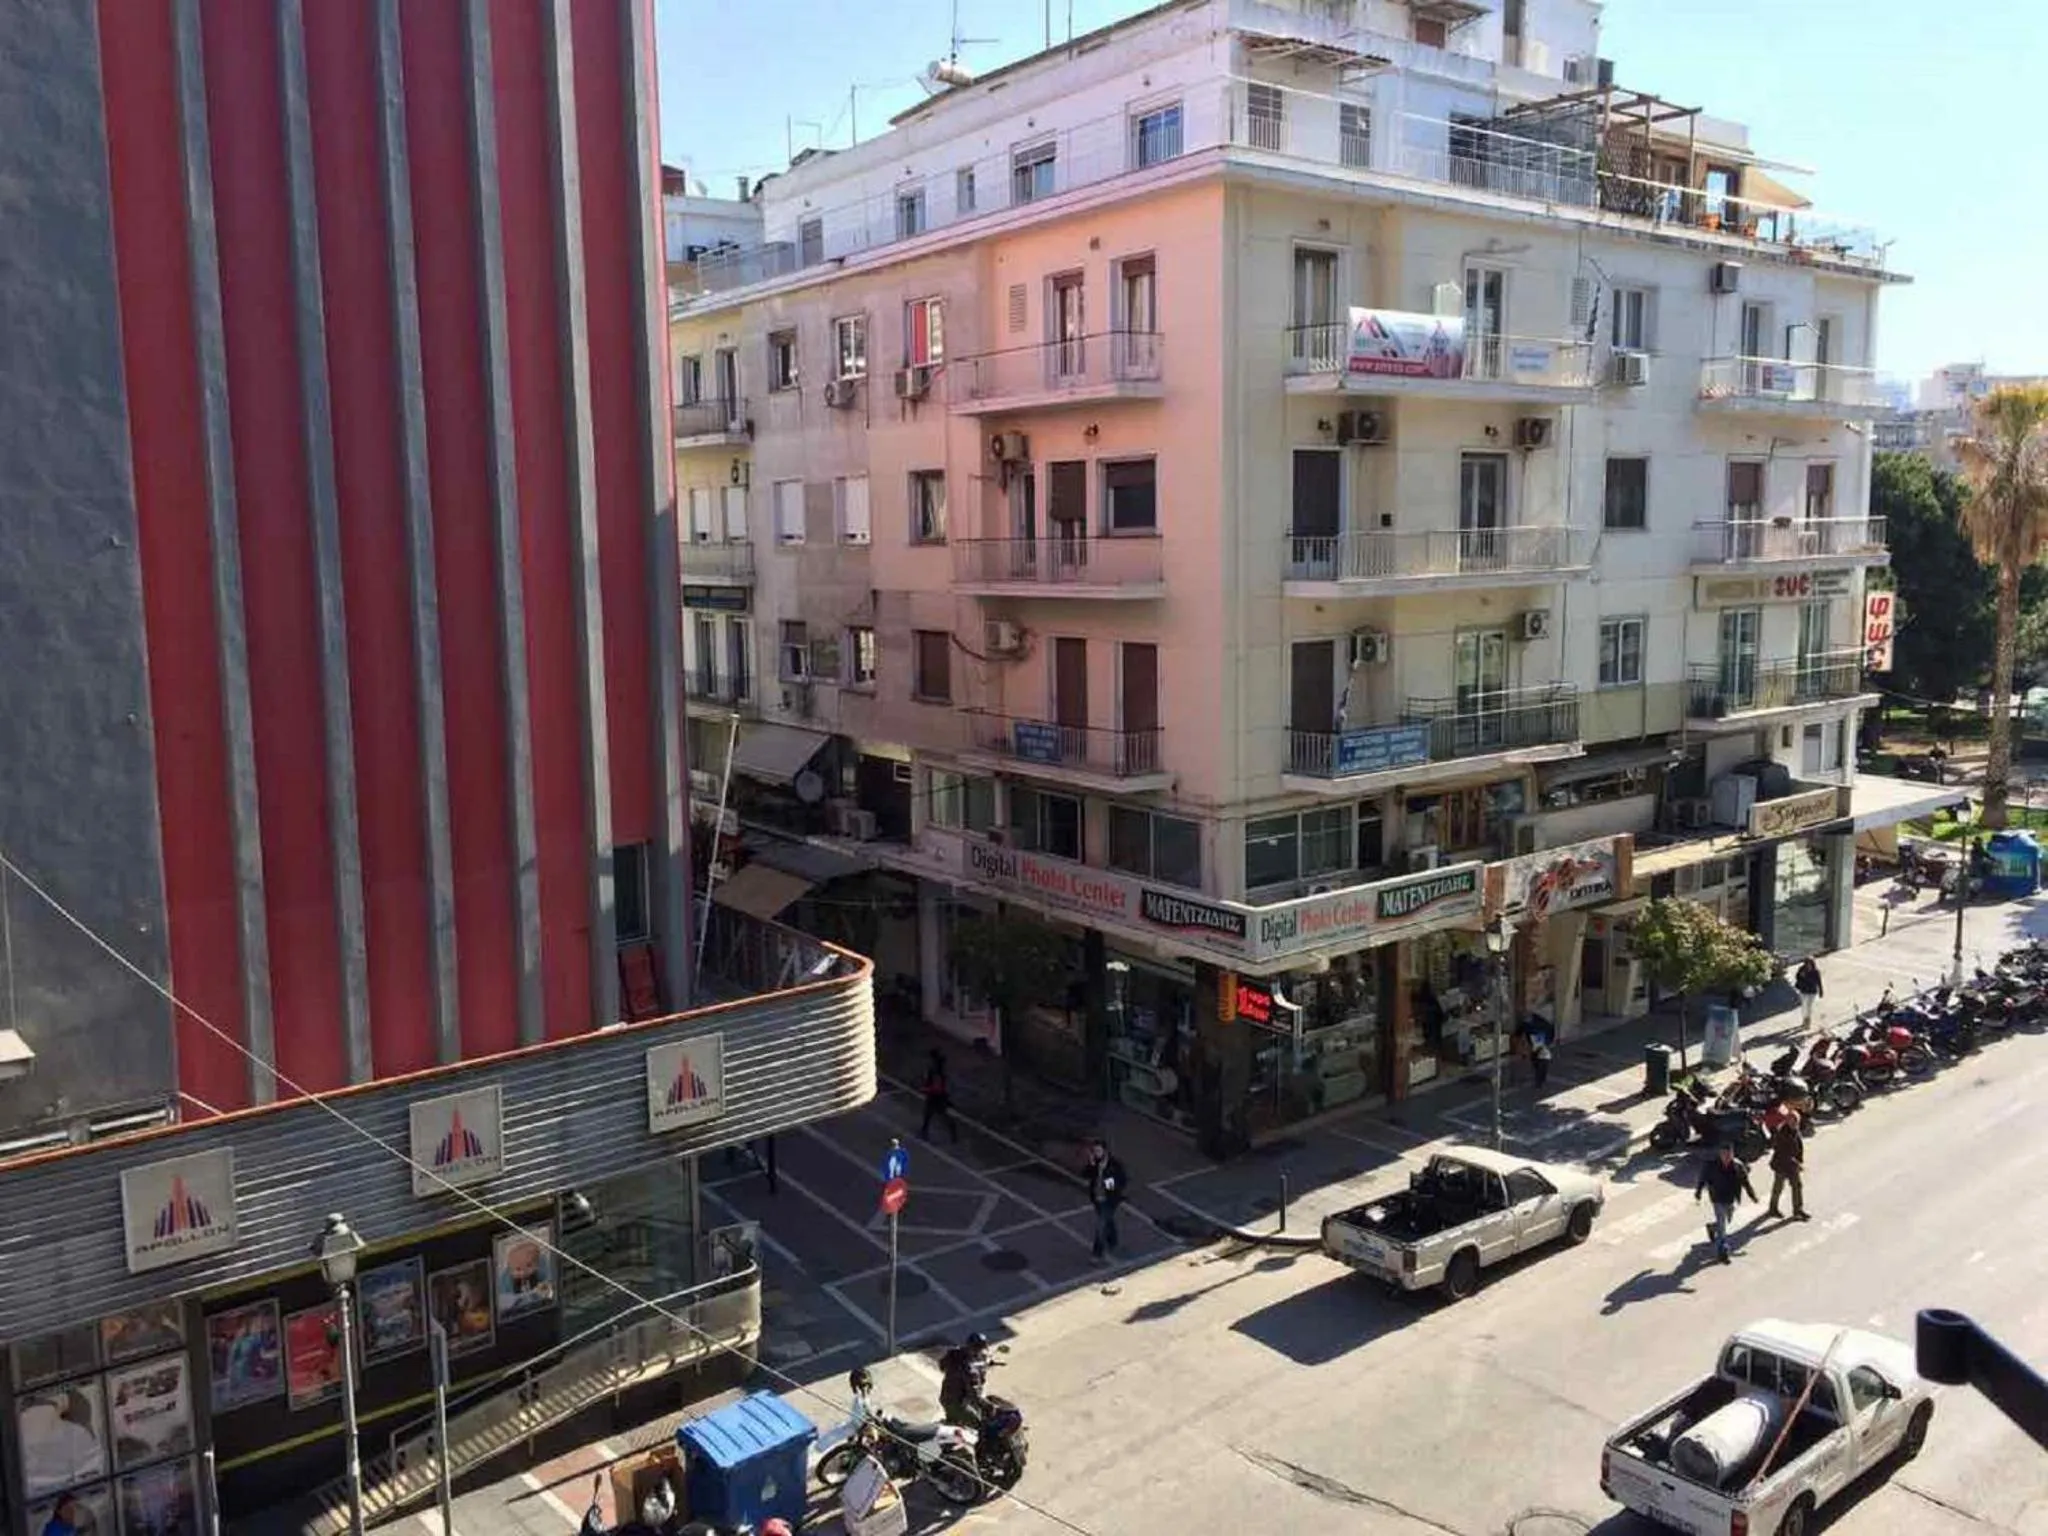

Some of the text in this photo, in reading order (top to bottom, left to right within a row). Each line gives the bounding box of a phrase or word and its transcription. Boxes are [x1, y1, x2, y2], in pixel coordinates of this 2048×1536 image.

[972, 846, 1017, 878] Digital
[1021, 854, 1067, 891] Photo
[1070, 874, 1126, 908] Center
[1261, 907, 1297, 950] Digital
[134, 1222, 231, 1254] APOLLON
